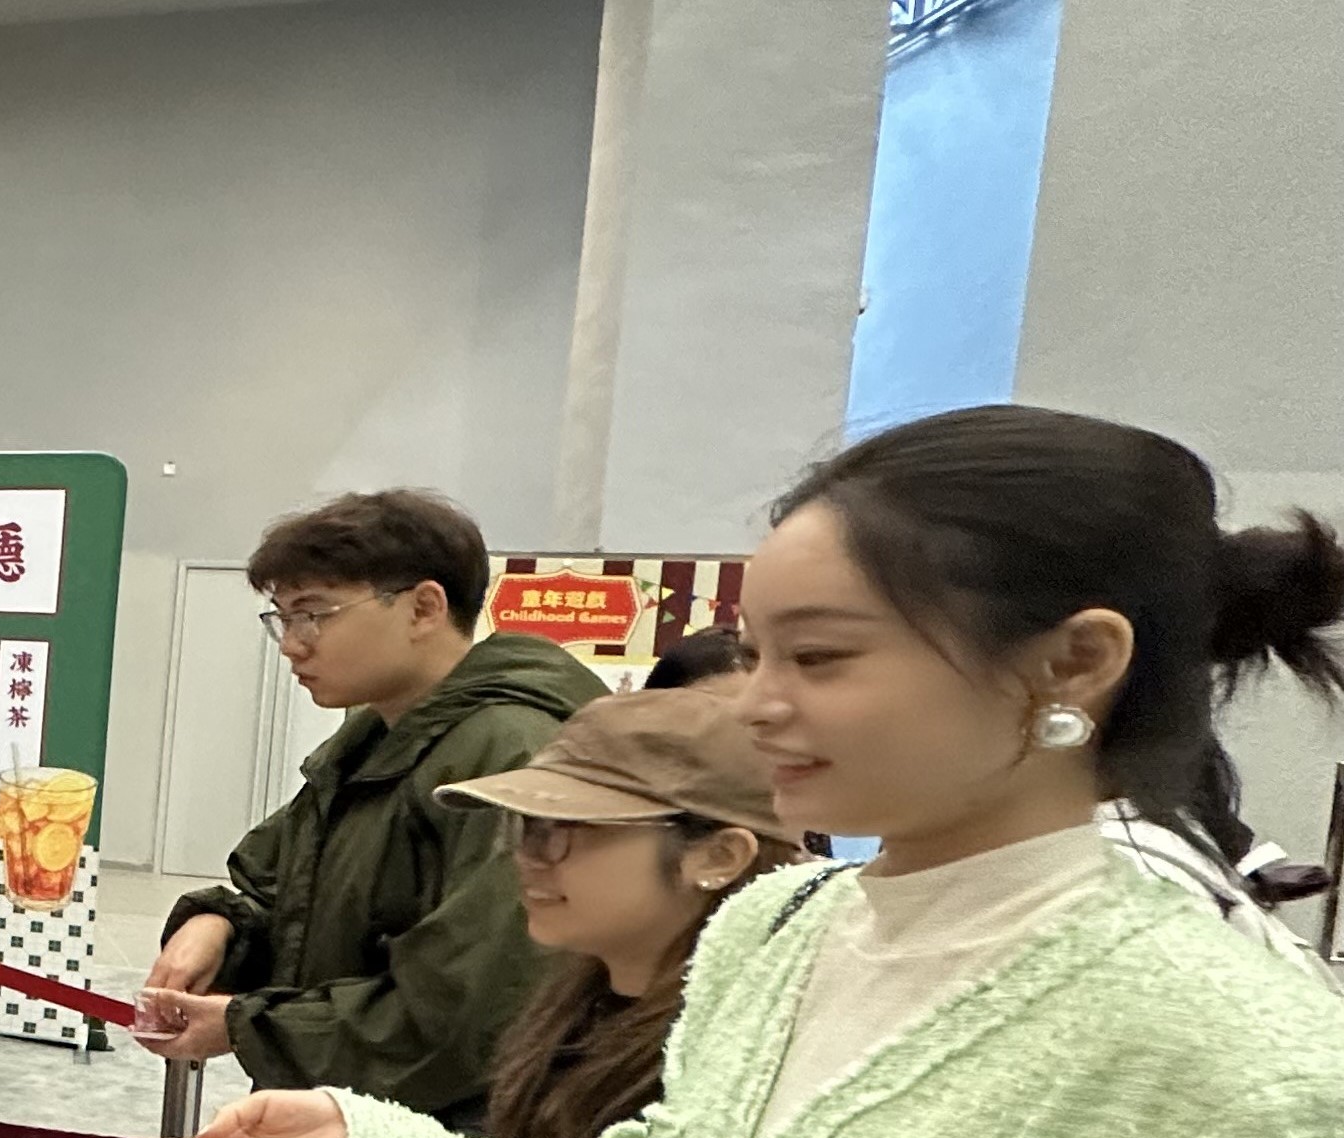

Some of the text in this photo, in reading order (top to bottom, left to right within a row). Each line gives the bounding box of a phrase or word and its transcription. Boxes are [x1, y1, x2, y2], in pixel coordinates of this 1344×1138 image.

[521, 589, 607, 609] 童年遊戲
[500, 610, 628, 624] Childhood Games
[7, 651, 35, 728] 凍檸茶
